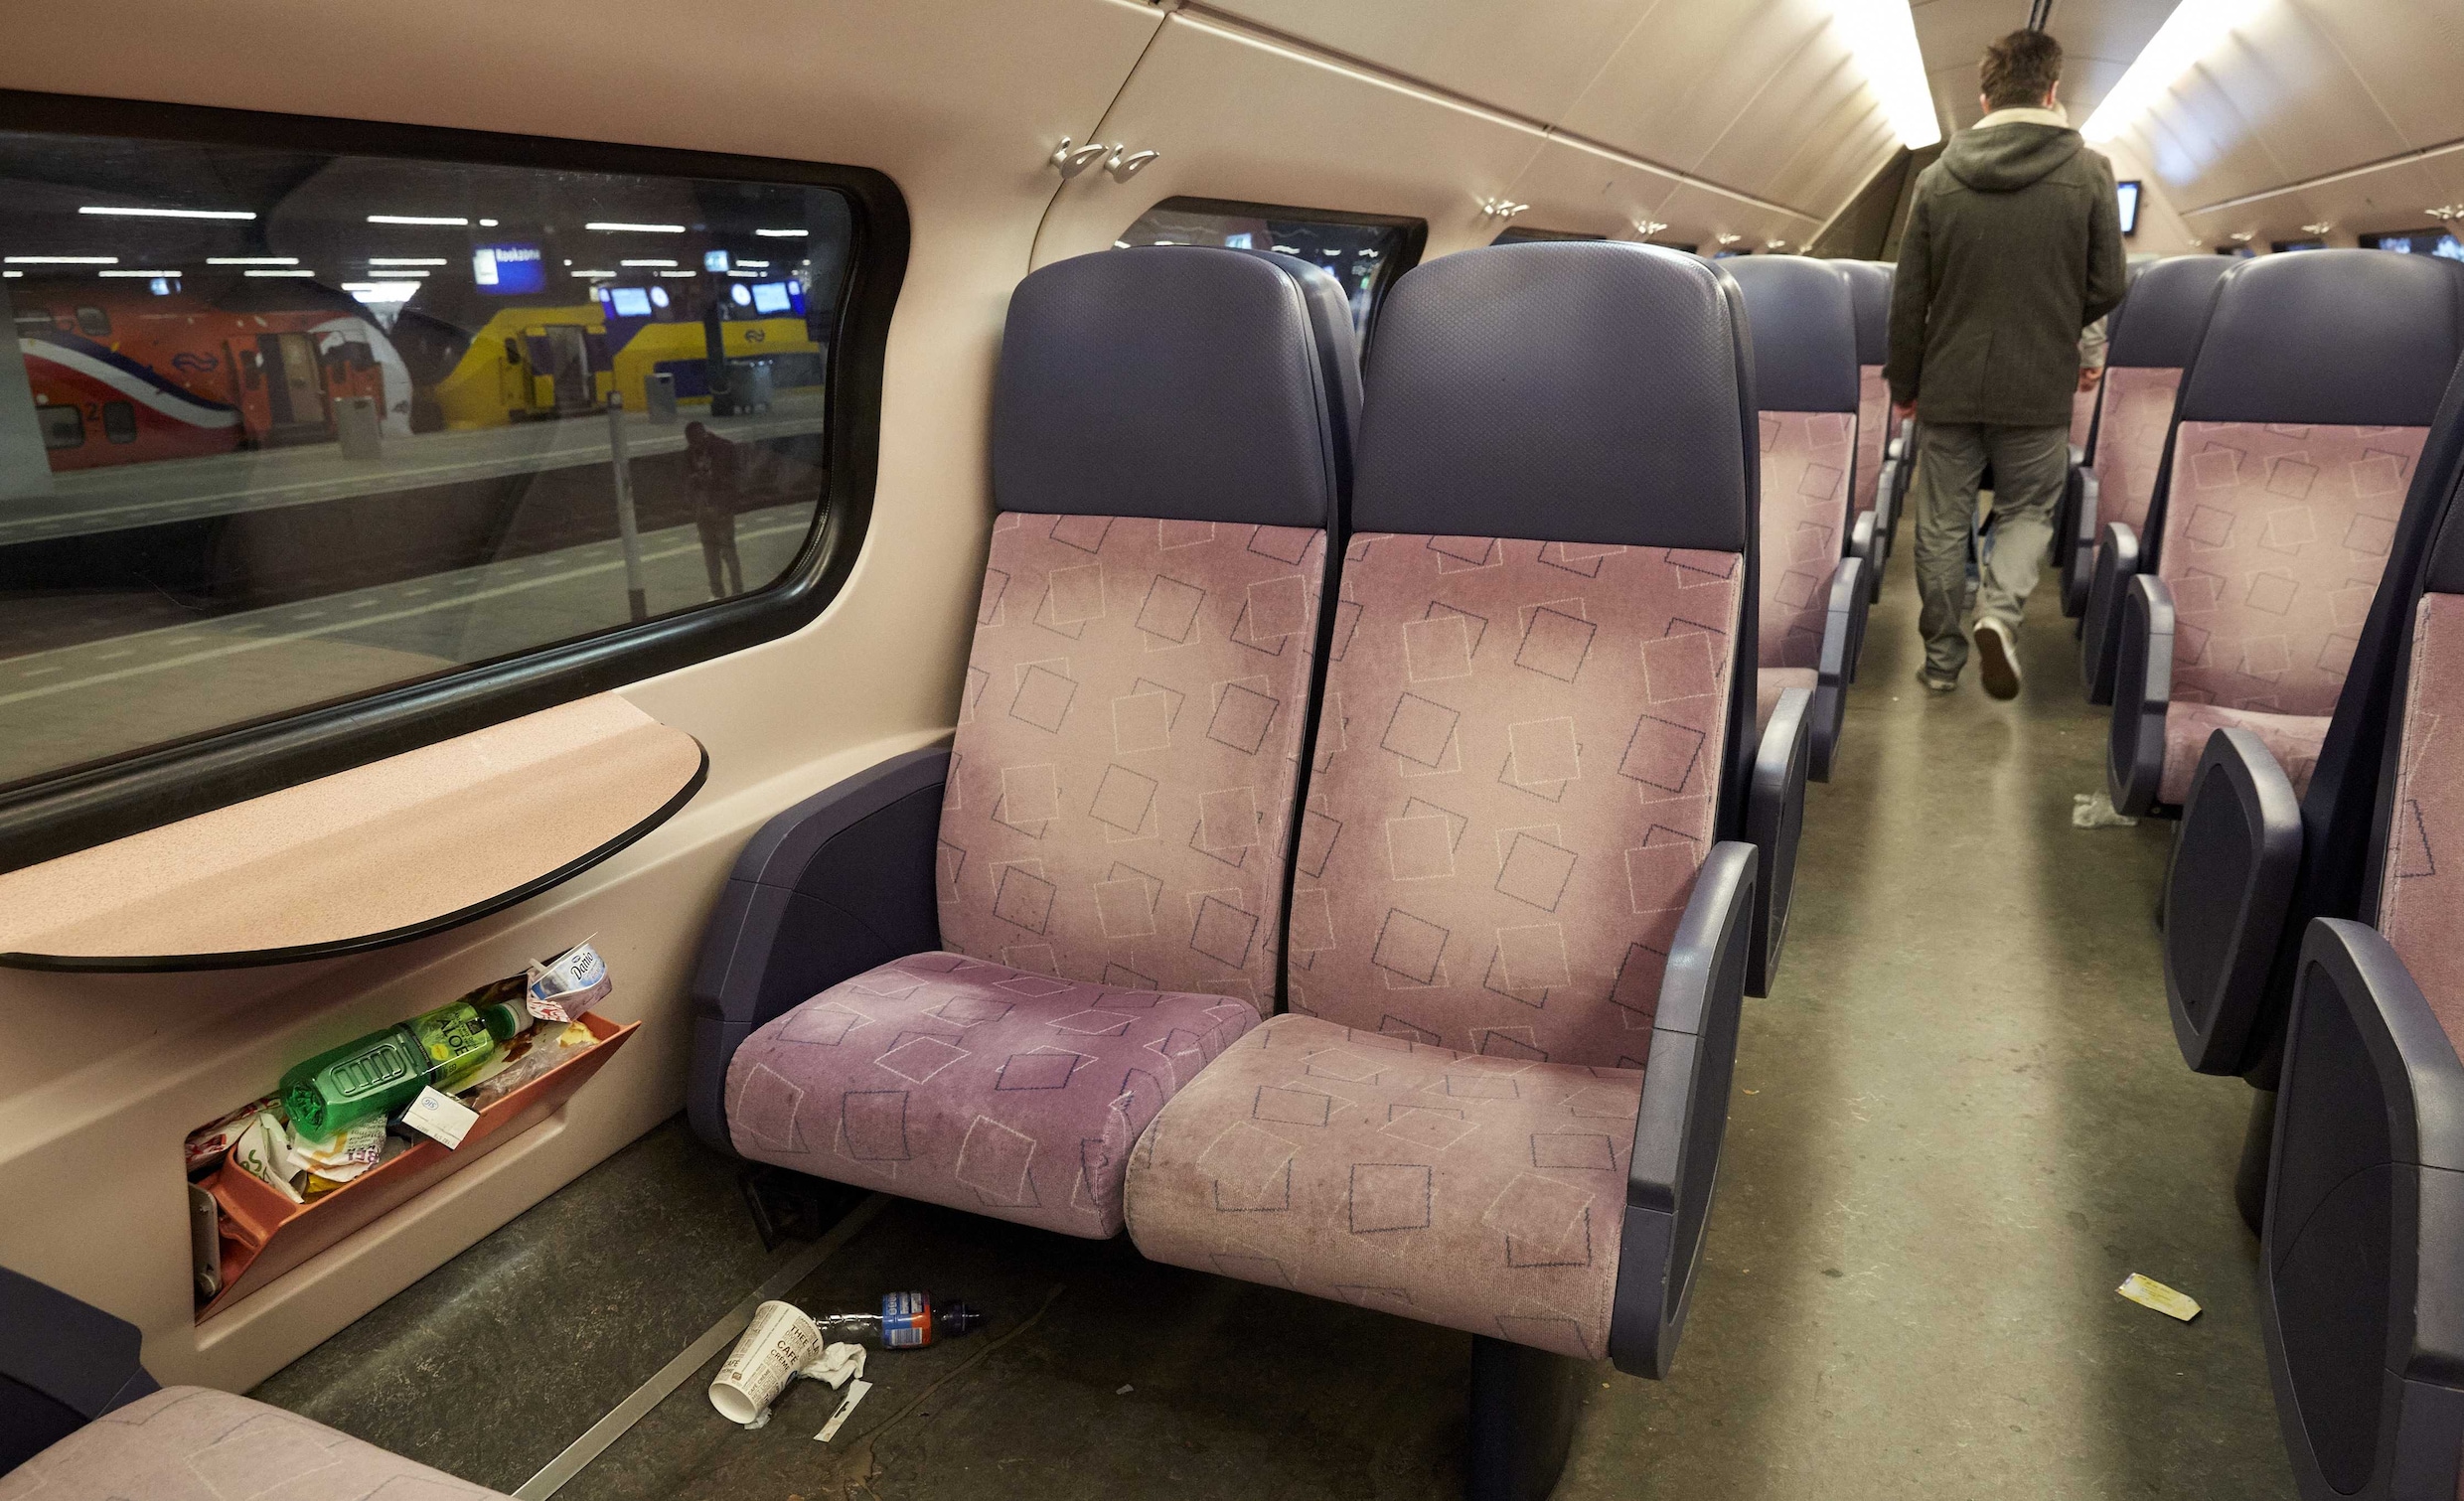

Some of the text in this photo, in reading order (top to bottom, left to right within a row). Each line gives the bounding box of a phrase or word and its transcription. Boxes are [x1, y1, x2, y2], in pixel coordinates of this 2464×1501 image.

[85, 402, 99, 421] 2
[570, 952, 594, 980] Danio
[436, 1020, 469, 1056] ALOE
[790, 1324, 809, 1347] THEE
[777, 1339, 799, 1366] CAFÉ
